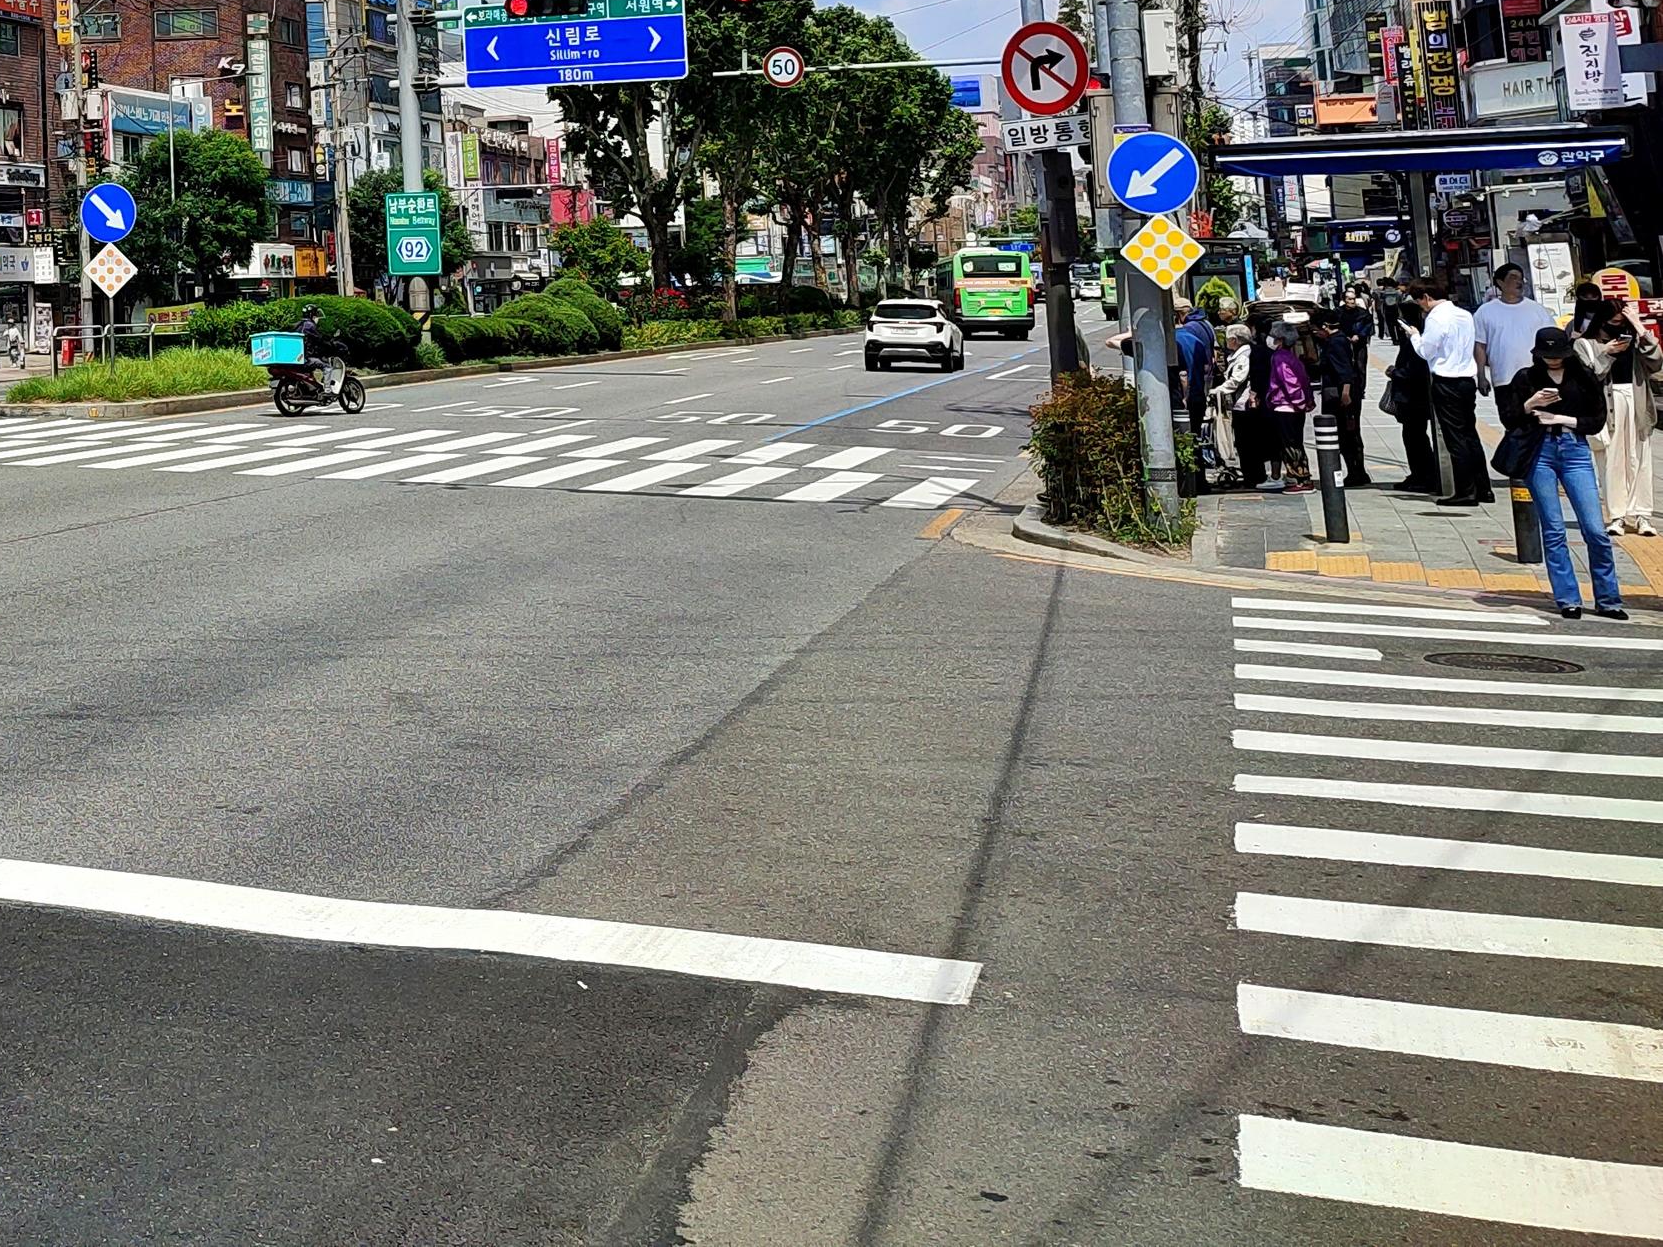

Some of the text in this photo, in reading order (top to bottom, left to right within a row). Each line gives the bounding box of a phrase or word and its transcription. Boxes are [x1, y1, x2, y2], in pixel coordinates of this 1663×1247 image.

[544, 25, 602, 50] 신림로
[217, 56, 245, 75] K9
[549, 50, 600, 63] Sillim-ro
[558, 69, 594, 83] 180m
[770, 58, 796, 76] 50
[1502, 79, 1533, 97] HAIR
[1560, 149, 1605, 163] 관악구
[388, 197, 436, 215] 남부순환로
[404, 240, 425, 258] 92
